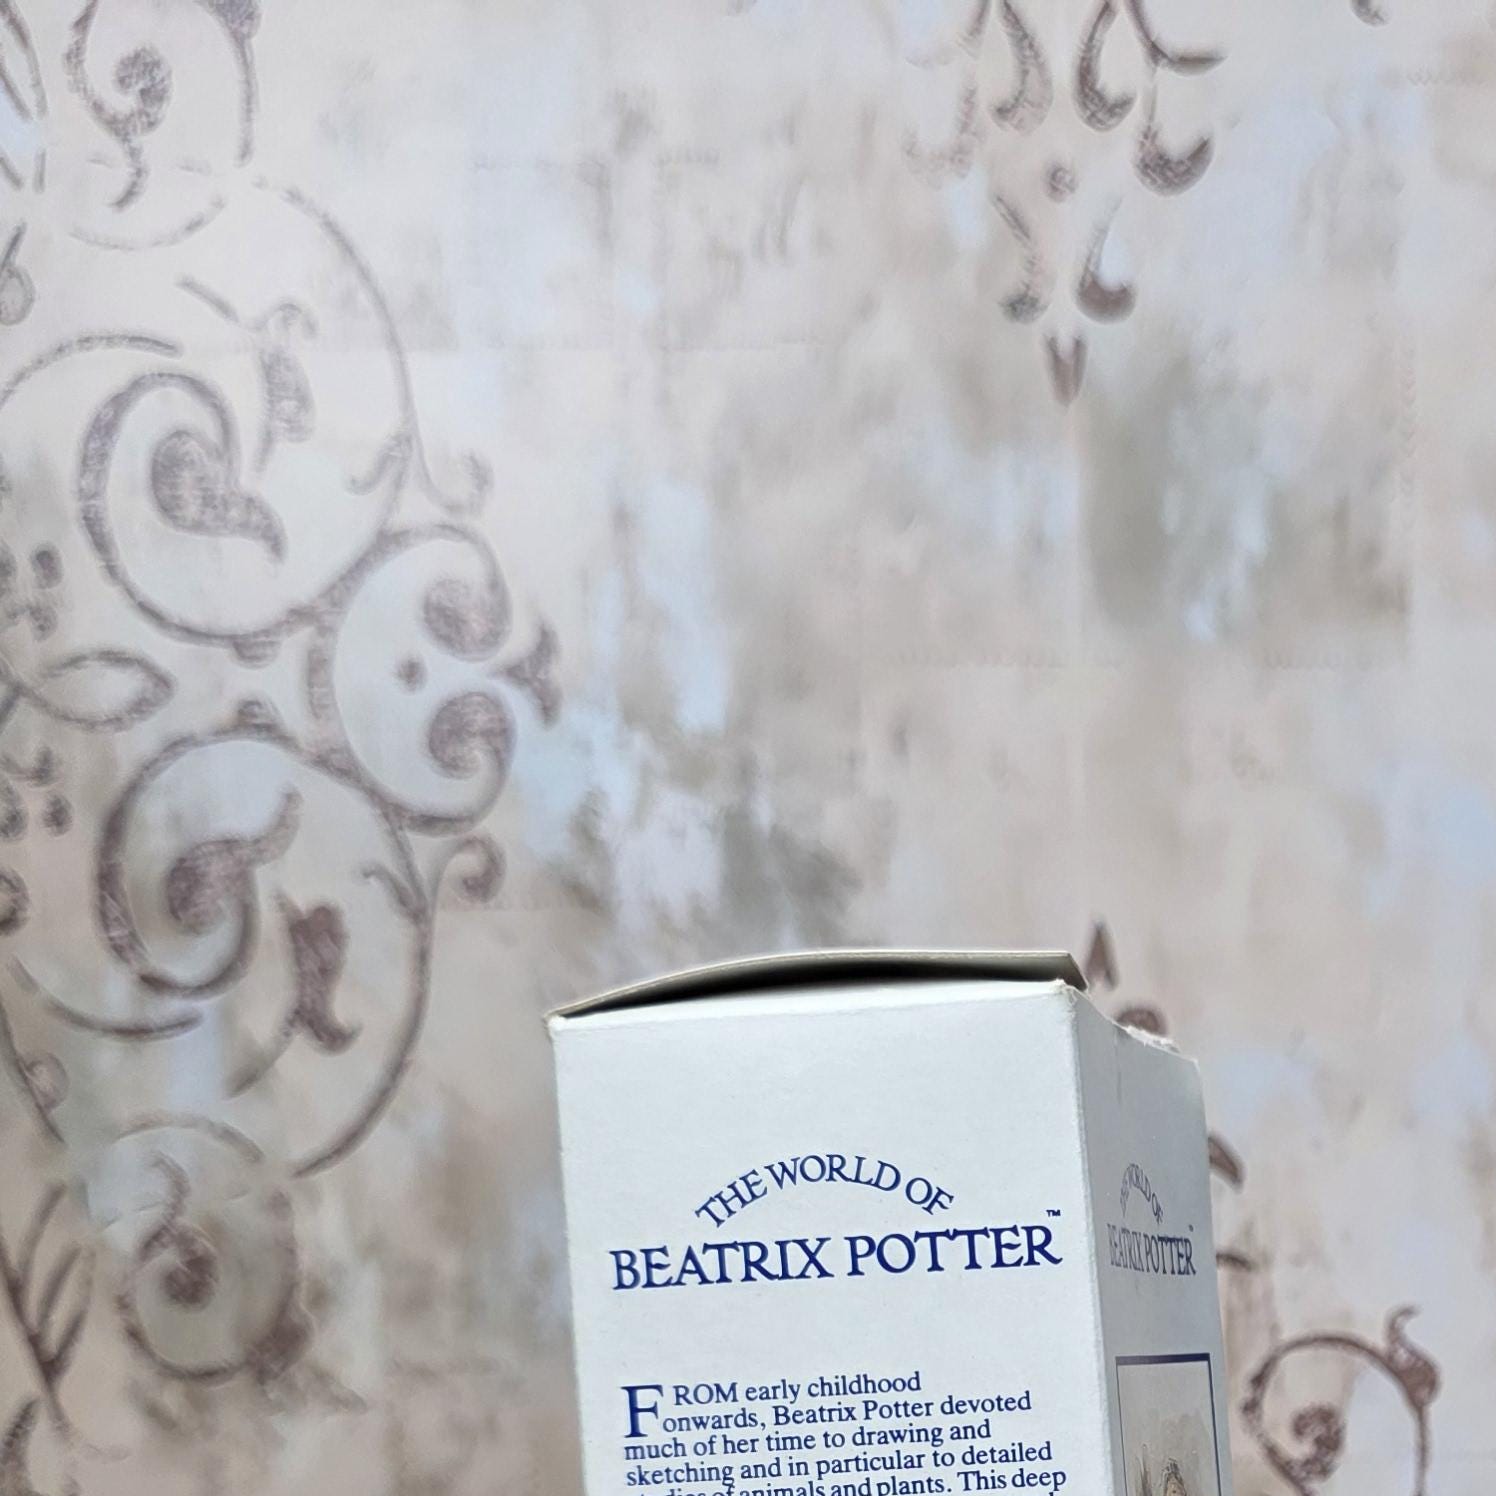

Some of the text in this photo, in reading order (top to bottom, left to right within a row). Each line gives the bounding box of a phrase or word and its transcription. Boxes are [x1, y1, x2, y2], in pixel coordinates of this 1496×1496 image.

[694, 1154, 954, 1228] THE WORLD OF
[609, 1225, 1063, 1290] BEATRIX POTTER
[1143, 1234, 1197, 1275] POTTER
[745, 1379, 800, 1404] early
[808, 1371, 921, 1397] childhood
[663, 1390, 1032, 1432] onwards, Beatrix Potter devoted
[624, 1418, 991, 1460] much of her time to drawing and
[627, 1441, 1052, 1488] sketching and in particular to detailed
[957, 1470, 1007, 1491] This
[1011, 1468, 1066, 1491] deep
